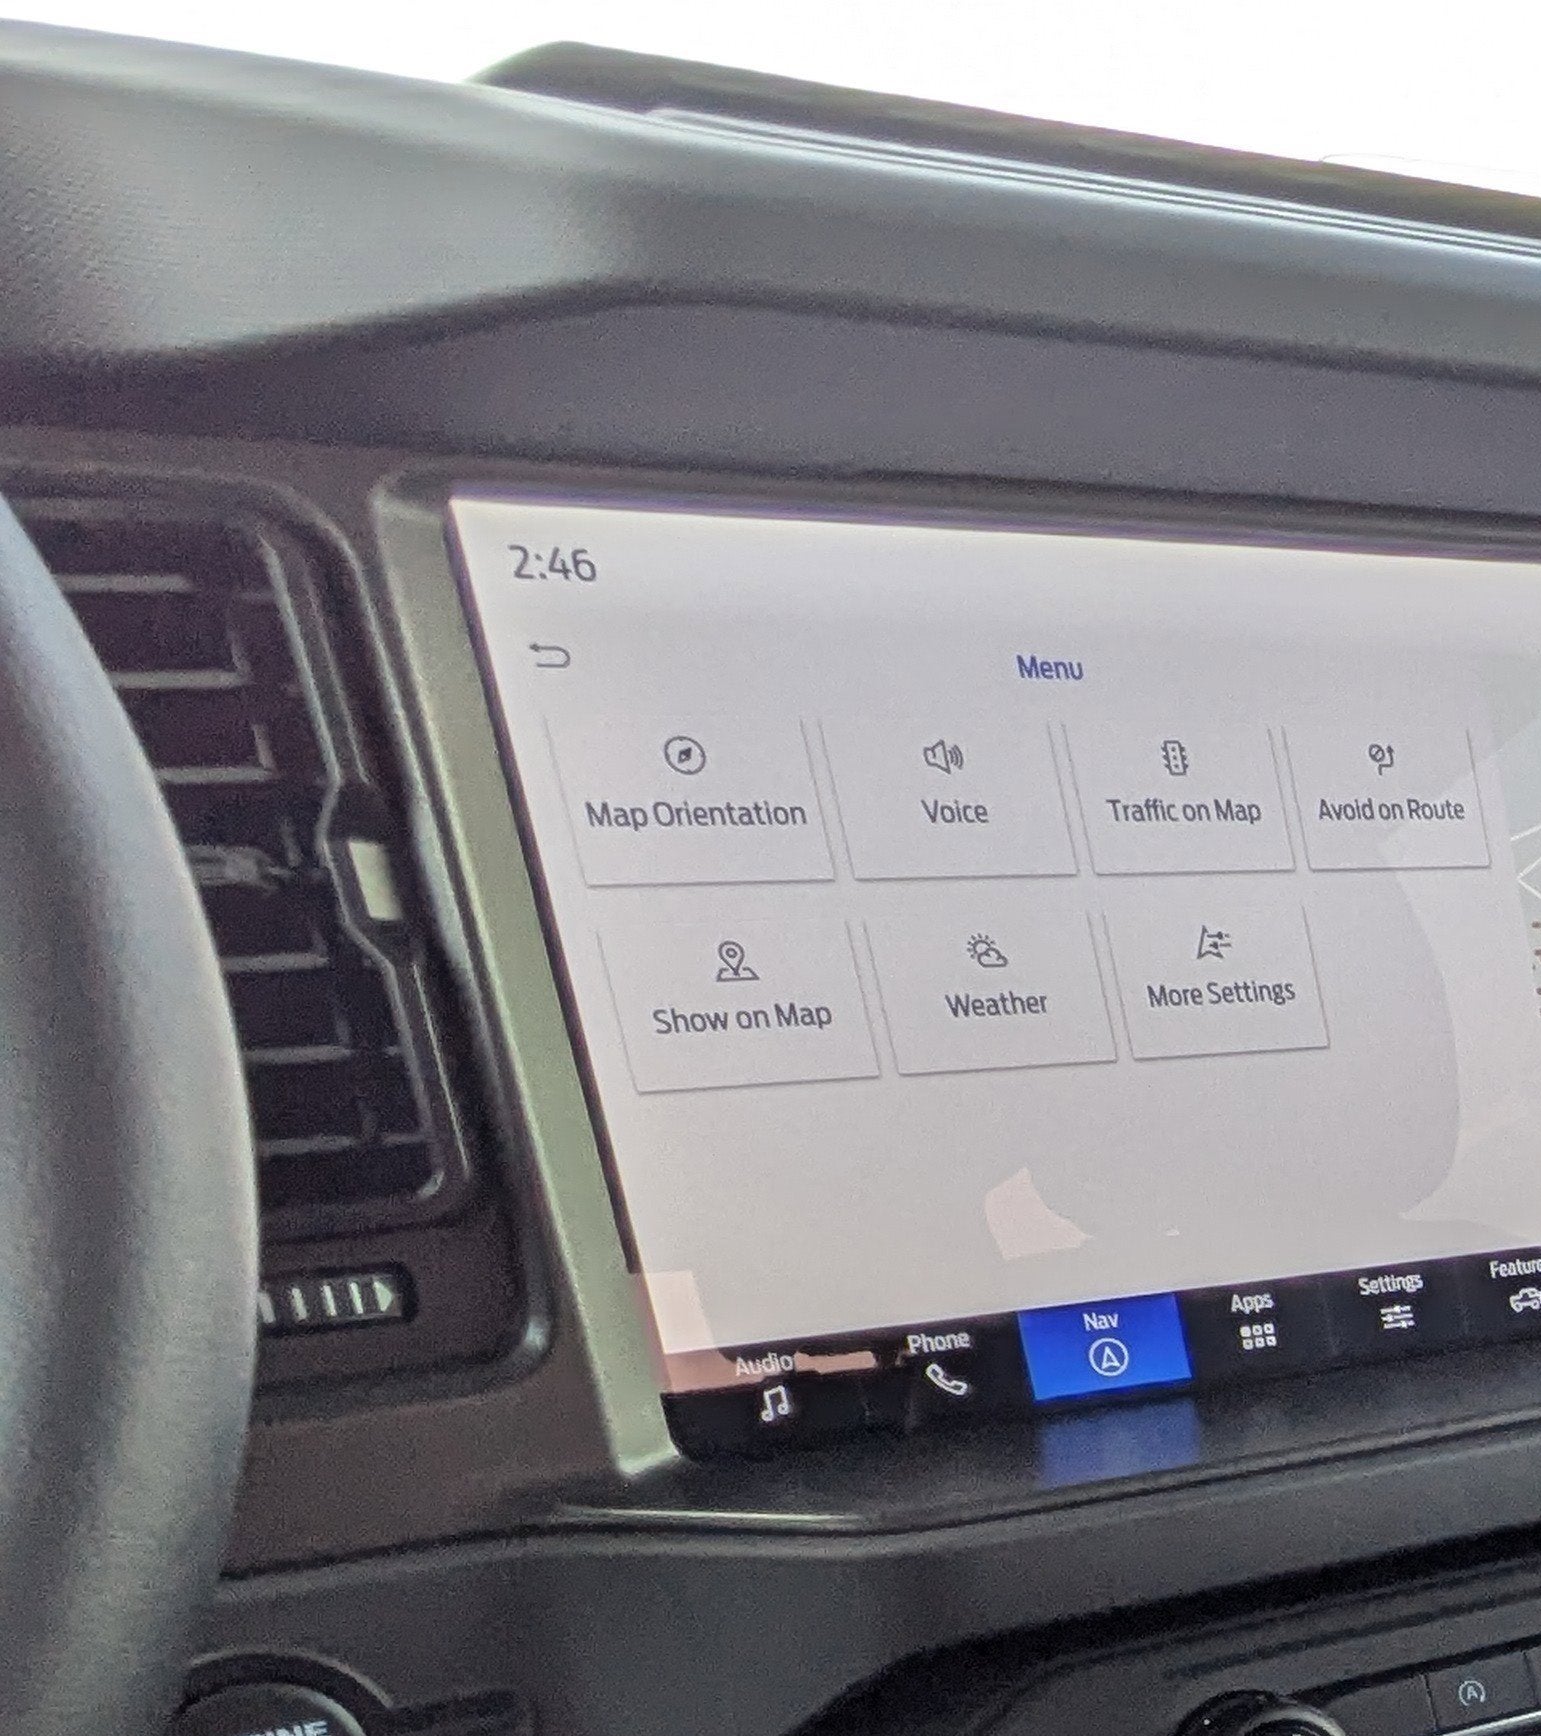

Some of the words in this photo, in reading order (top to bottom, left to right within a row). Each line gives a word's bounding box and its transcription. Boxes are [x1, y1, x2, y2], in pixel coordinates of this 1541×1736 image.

[508, 544, 597, 583] 2:46
[1017, 655, 1083, 681] Menu
[587, 800, 649, 831] Map
[653, 800, 807, 828] Orientation
[921, 801, 989, 825] Voice
[1106, 798, 1178, 823] Traffic
[1183, 804, 1210, 822] on
[1215, 800, 1262, 824] Map
[1319, 798, 1374, 821] Avoid
[1379, 803, 1404, 820] on
[1408, 798, 1465, 820] Route
[945, 990, 1048, 1018] Weather
[1147, 984, 1201, 1008] More
[1207, 979, 1296, 1006] Settings
[653, 1005, 728, 1035] Show
[736, 1009, 770, 1031] on
[776, 1004, 833, 1033] Map
[1358, 1272, 1423, 1297] Settings
[1231, 1292, 1273, 1315] Apps
[1083, 1311, 1119, 1331] Nav
[906, 1330, 970, 1355] Phone
[734, 1352, 793, 1377] Audio
